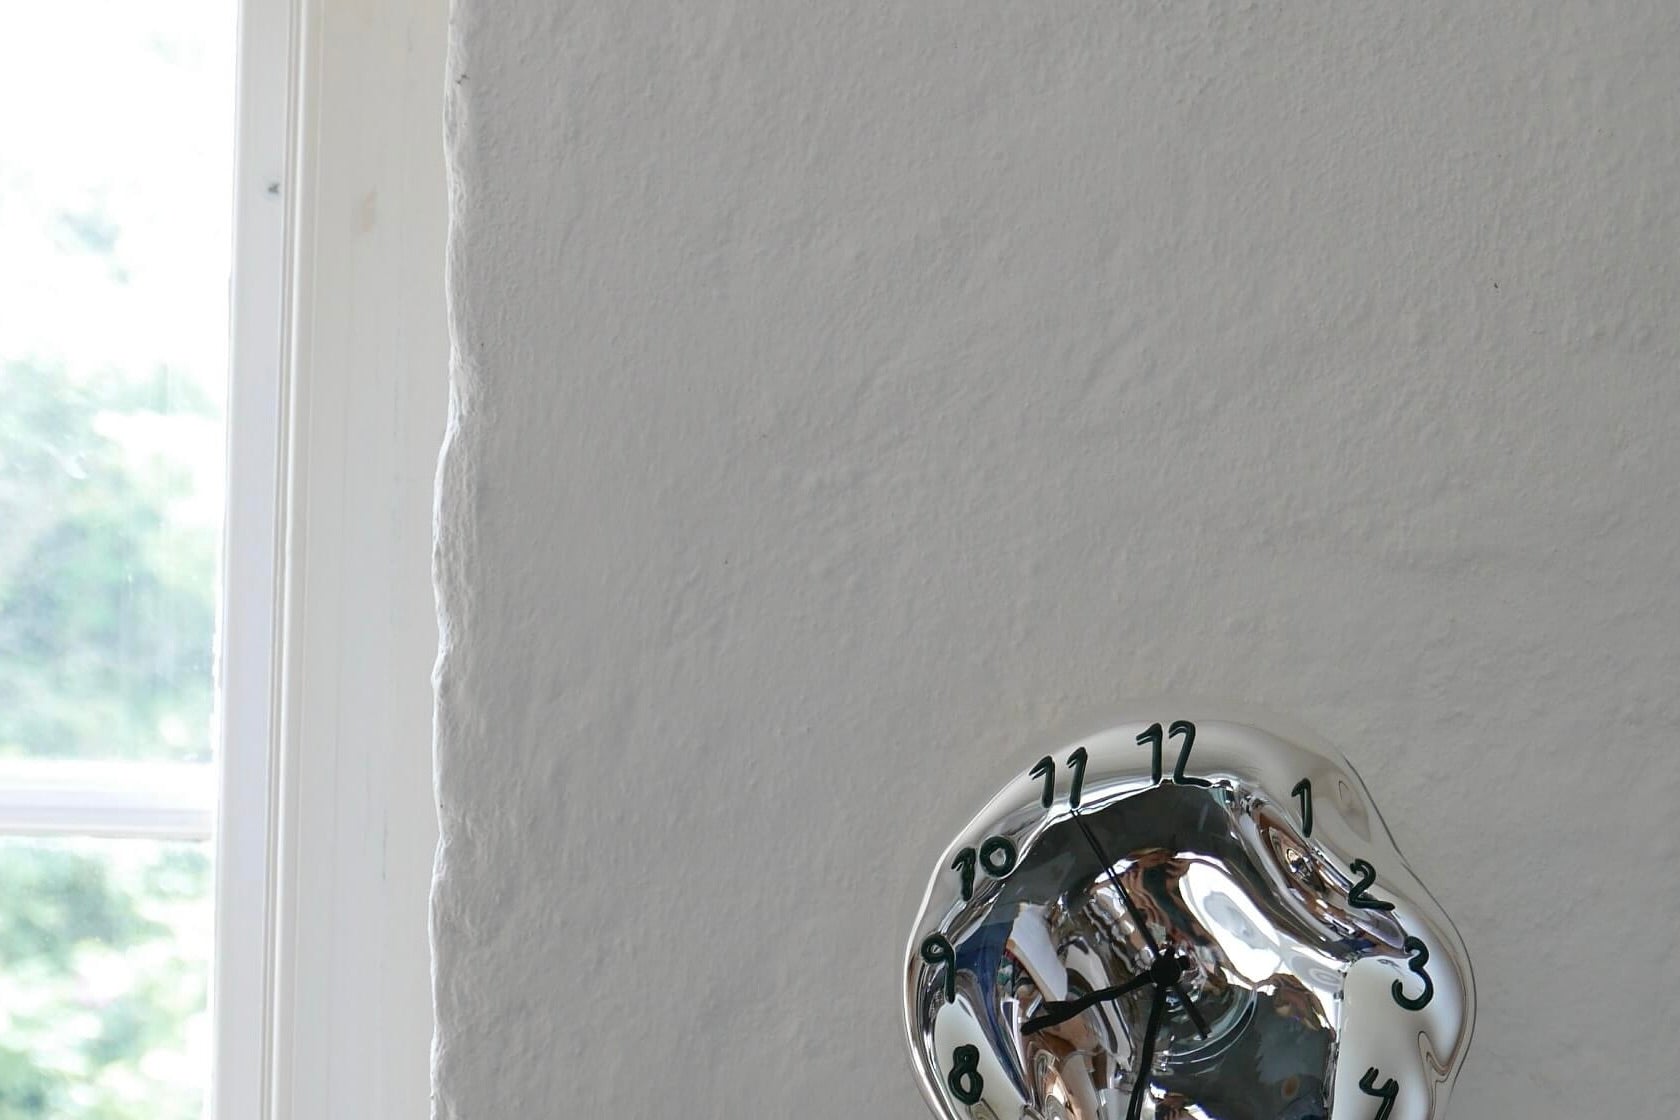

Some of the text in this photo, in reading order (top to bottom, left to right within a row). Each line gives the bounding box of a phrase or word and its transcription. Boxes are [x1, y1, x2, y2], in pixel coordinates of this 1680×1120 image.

[1029, 746, 1088, 809] 11
[1136, 720, 1212, 788] 12
[1291, 777, 1313, 838] 1
[951, 836, 1016, 901] 10
[1348, 858, 1395, 910] 2
[921, 933, 955, 1003] 9
[1391, 936, 1434, 1010] 3
[948, 1044, 984, 1105] 8
